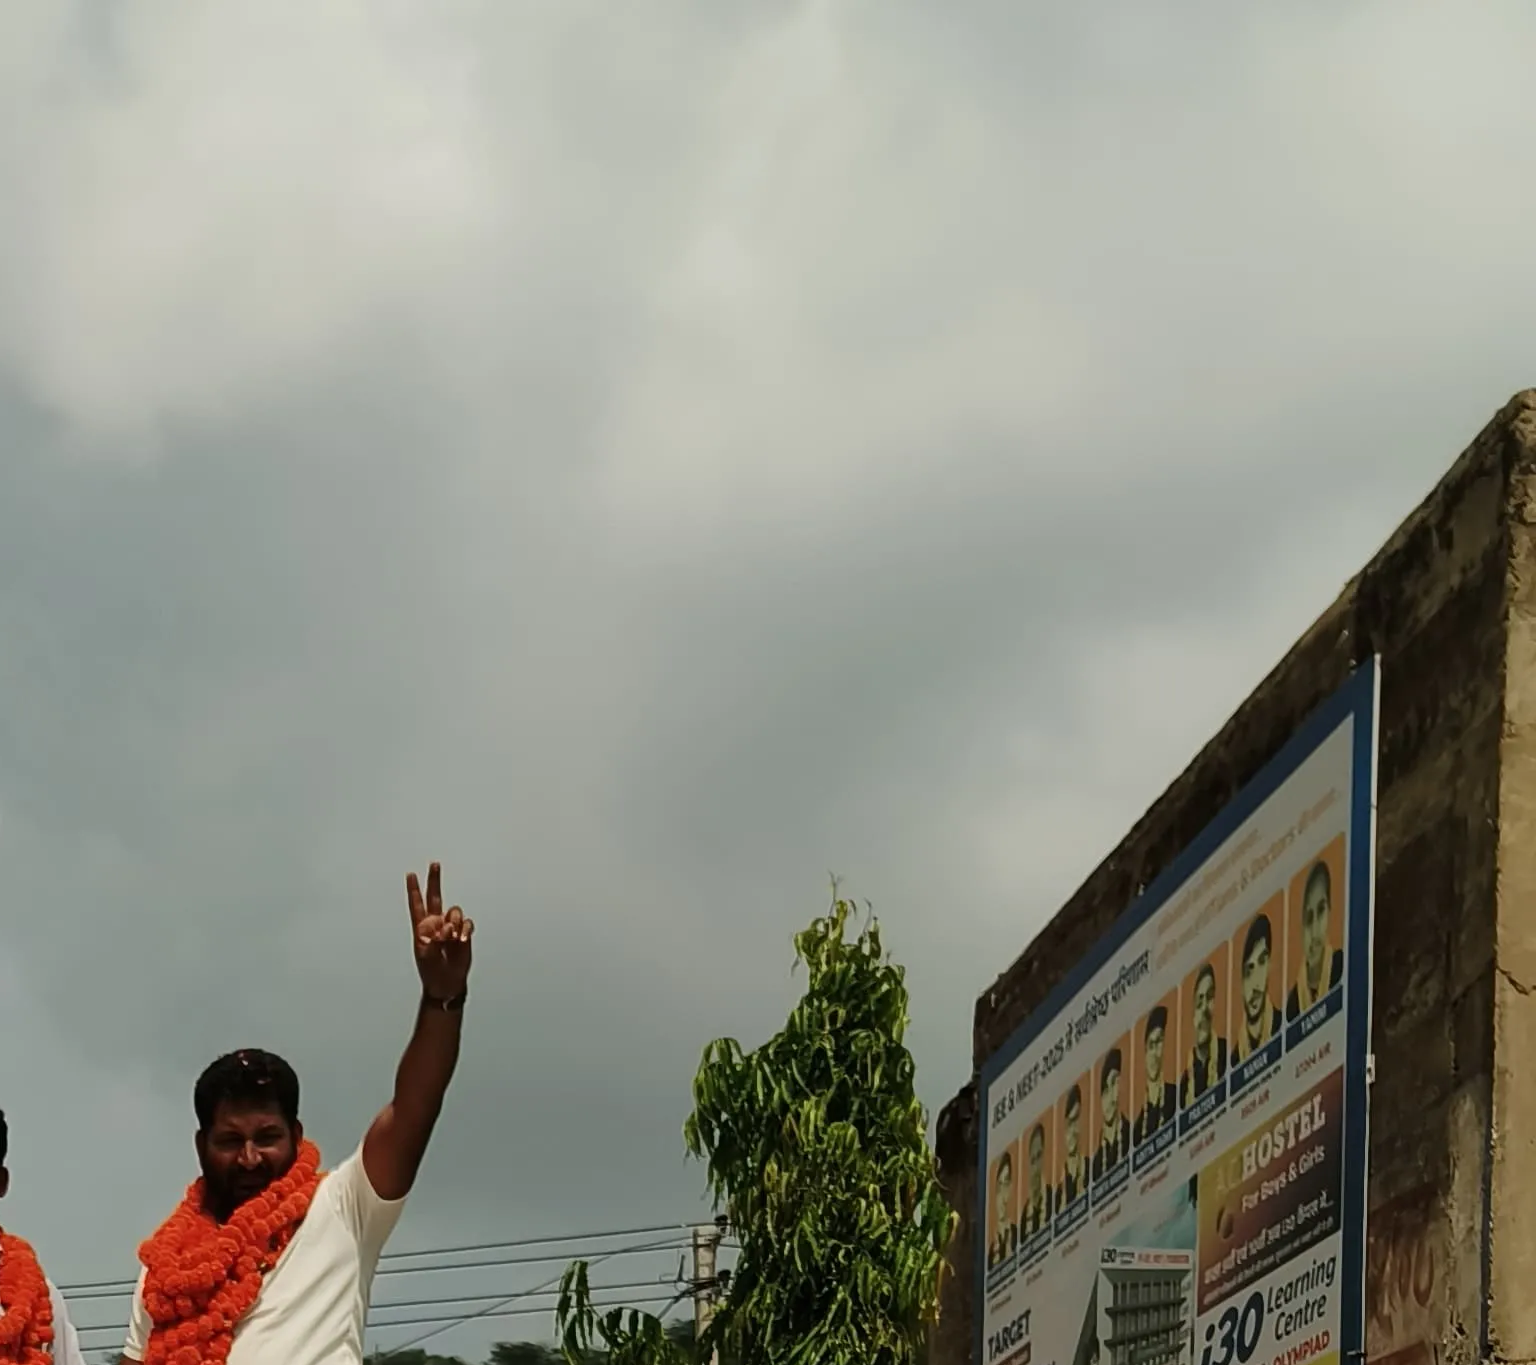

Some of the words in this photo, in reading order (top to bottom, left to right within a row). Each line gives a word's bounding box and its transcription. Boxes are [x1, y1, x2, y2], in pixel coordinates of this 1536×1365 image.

[992, 1095, 1006, 1128] JEE
[1008, 1087, 1014, 1112] &
[1241, 1094, 1326, 1180] HOSTEL
[1241, 1190, 1258, 1213] For
[1261, 1171, 1286, 1200] Boys
[1288, 1161, 1297, 1182] &
[1298, 1144, 1325, 1174] Girls
[1266, 1256, 1336, 1317] Learning
[987, 1308, 1031, 1361] TARGET
[1274, 1293, 1326, 1341] Centre
